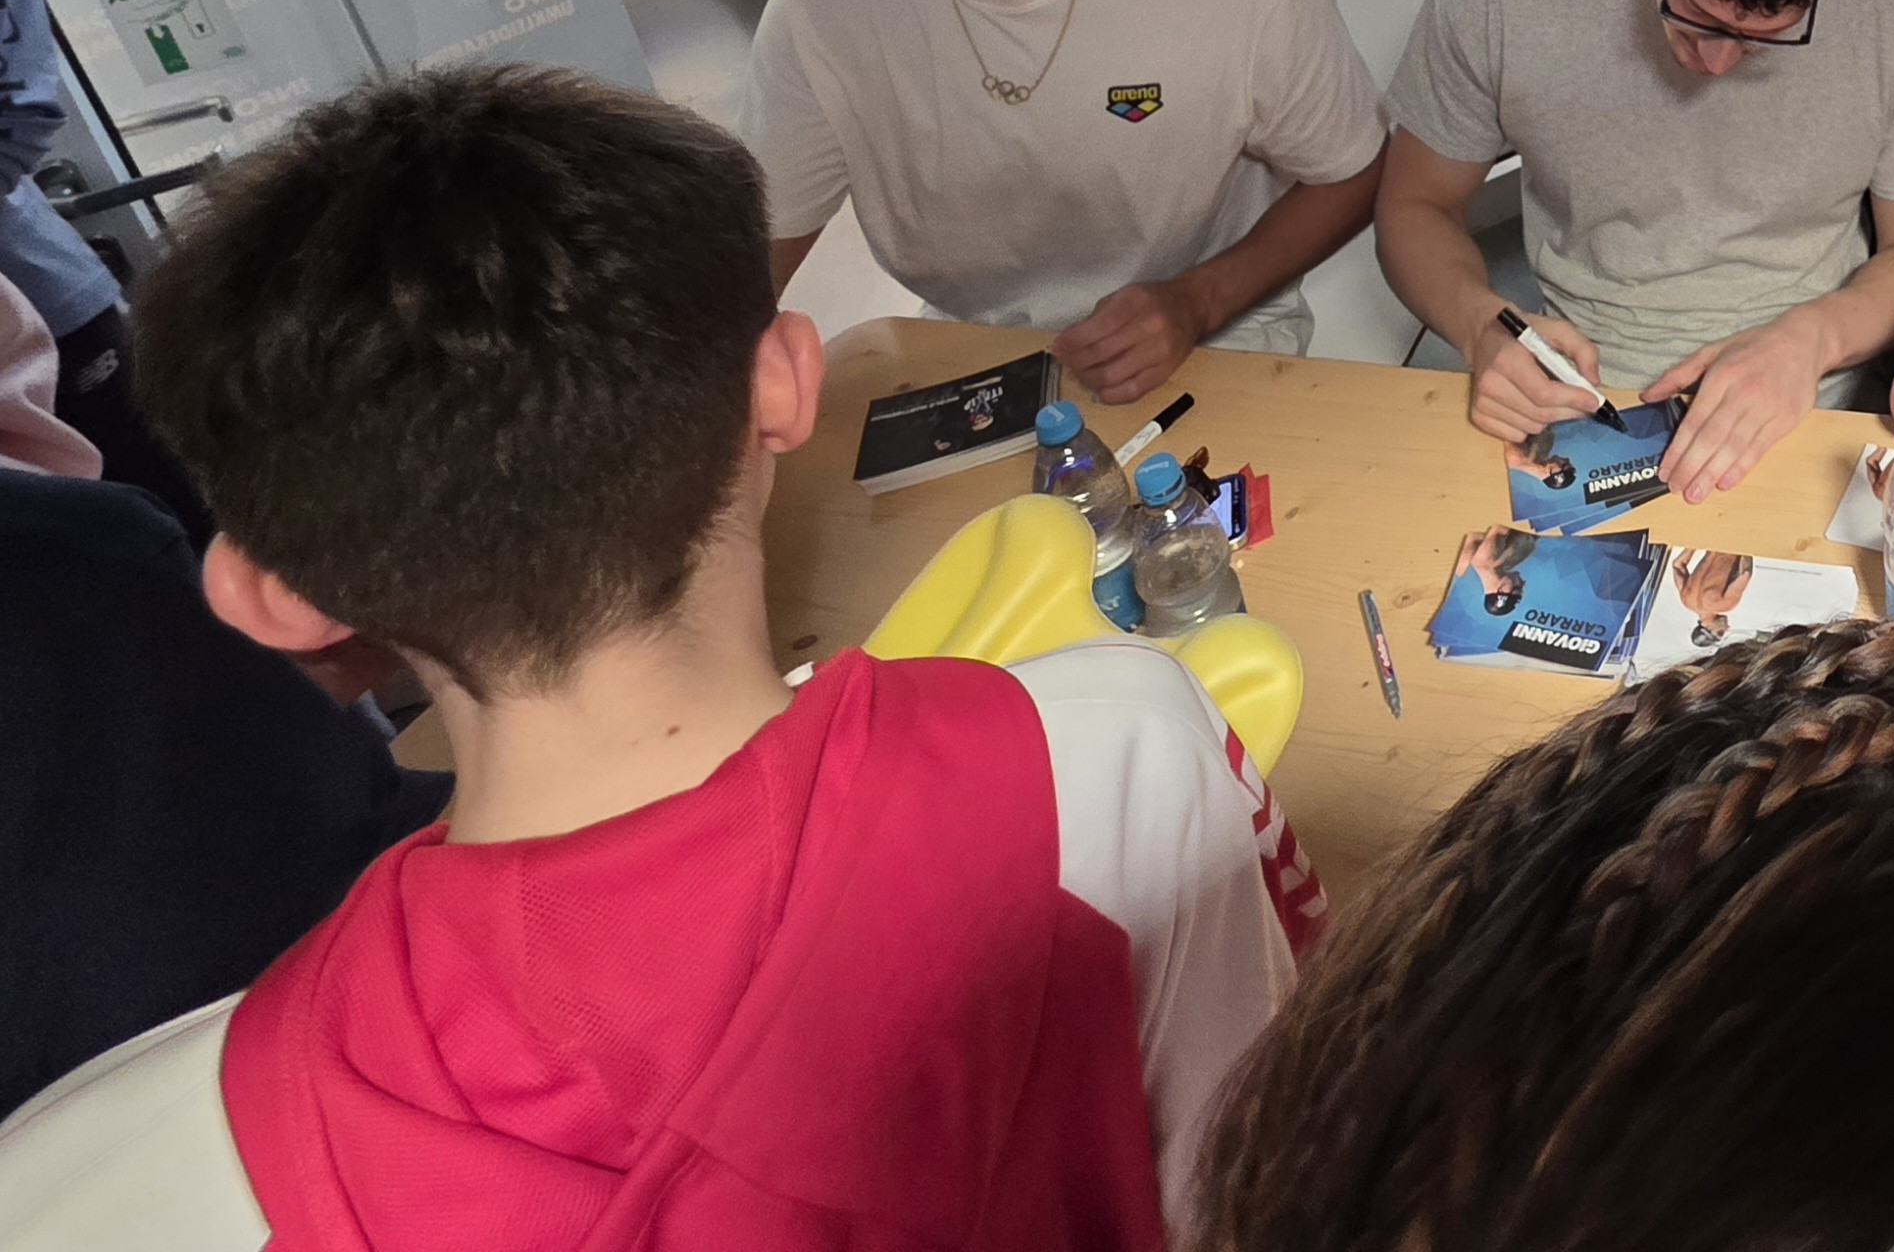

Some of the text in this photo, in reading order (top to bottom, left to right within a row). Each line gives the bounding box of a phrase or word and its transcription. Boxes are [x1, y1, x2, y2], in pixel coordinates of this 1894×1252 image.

[1111, 84, 1159, 102] arena
[1588, 453, 1660, 479] ARRARO
[1588, 465, 1660, 495] IOVANNI
[1525, 608, 1607, 637] CARRARO
[1512, 623, 1601, 655] GIOVANNI
